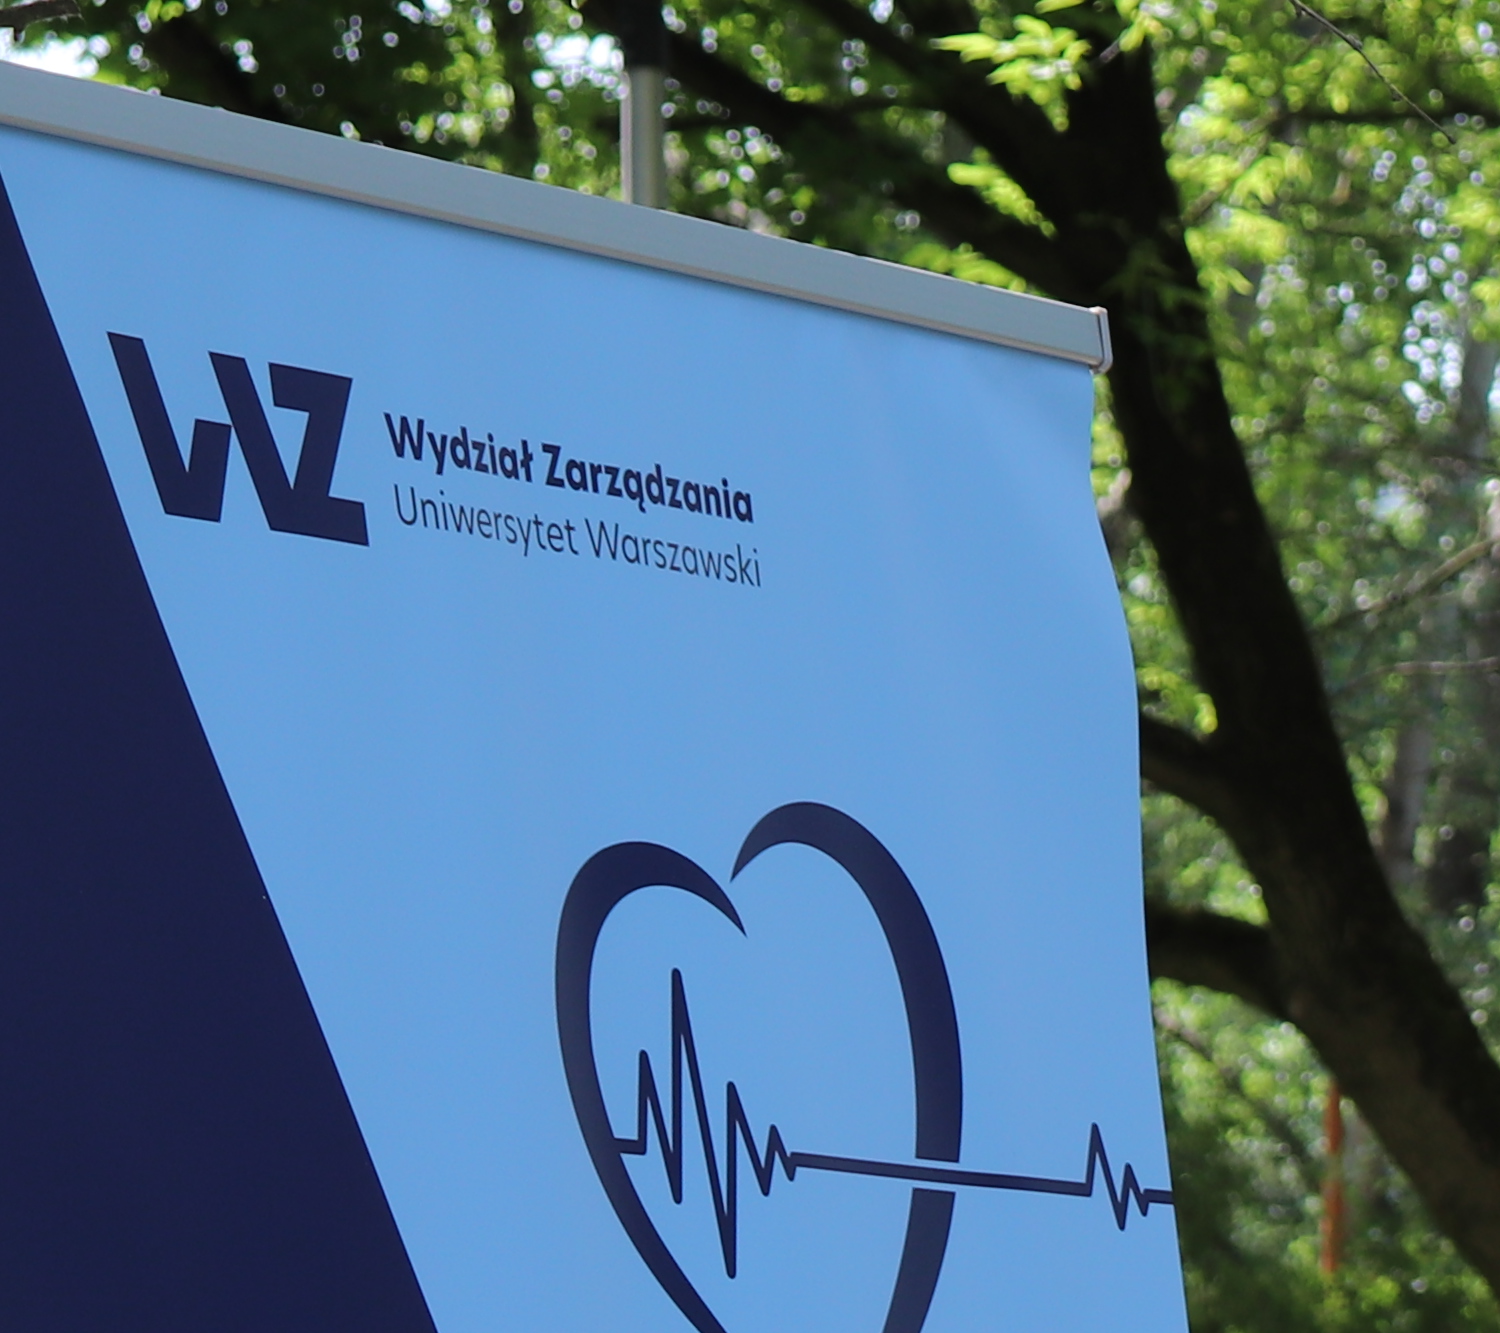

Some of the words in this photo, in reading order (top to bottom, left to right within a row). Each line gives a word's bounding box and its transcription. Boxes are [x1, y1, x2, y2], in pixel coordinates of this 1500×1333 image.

[106, 331, 369, 546] WZ
[384, 411, 533, 482] Wydział
[541, 443, 753, 522] Zarządzania
[393, 483, 579, 557] Uniwersytet
[585, 519, 761, 588] Warszawski
